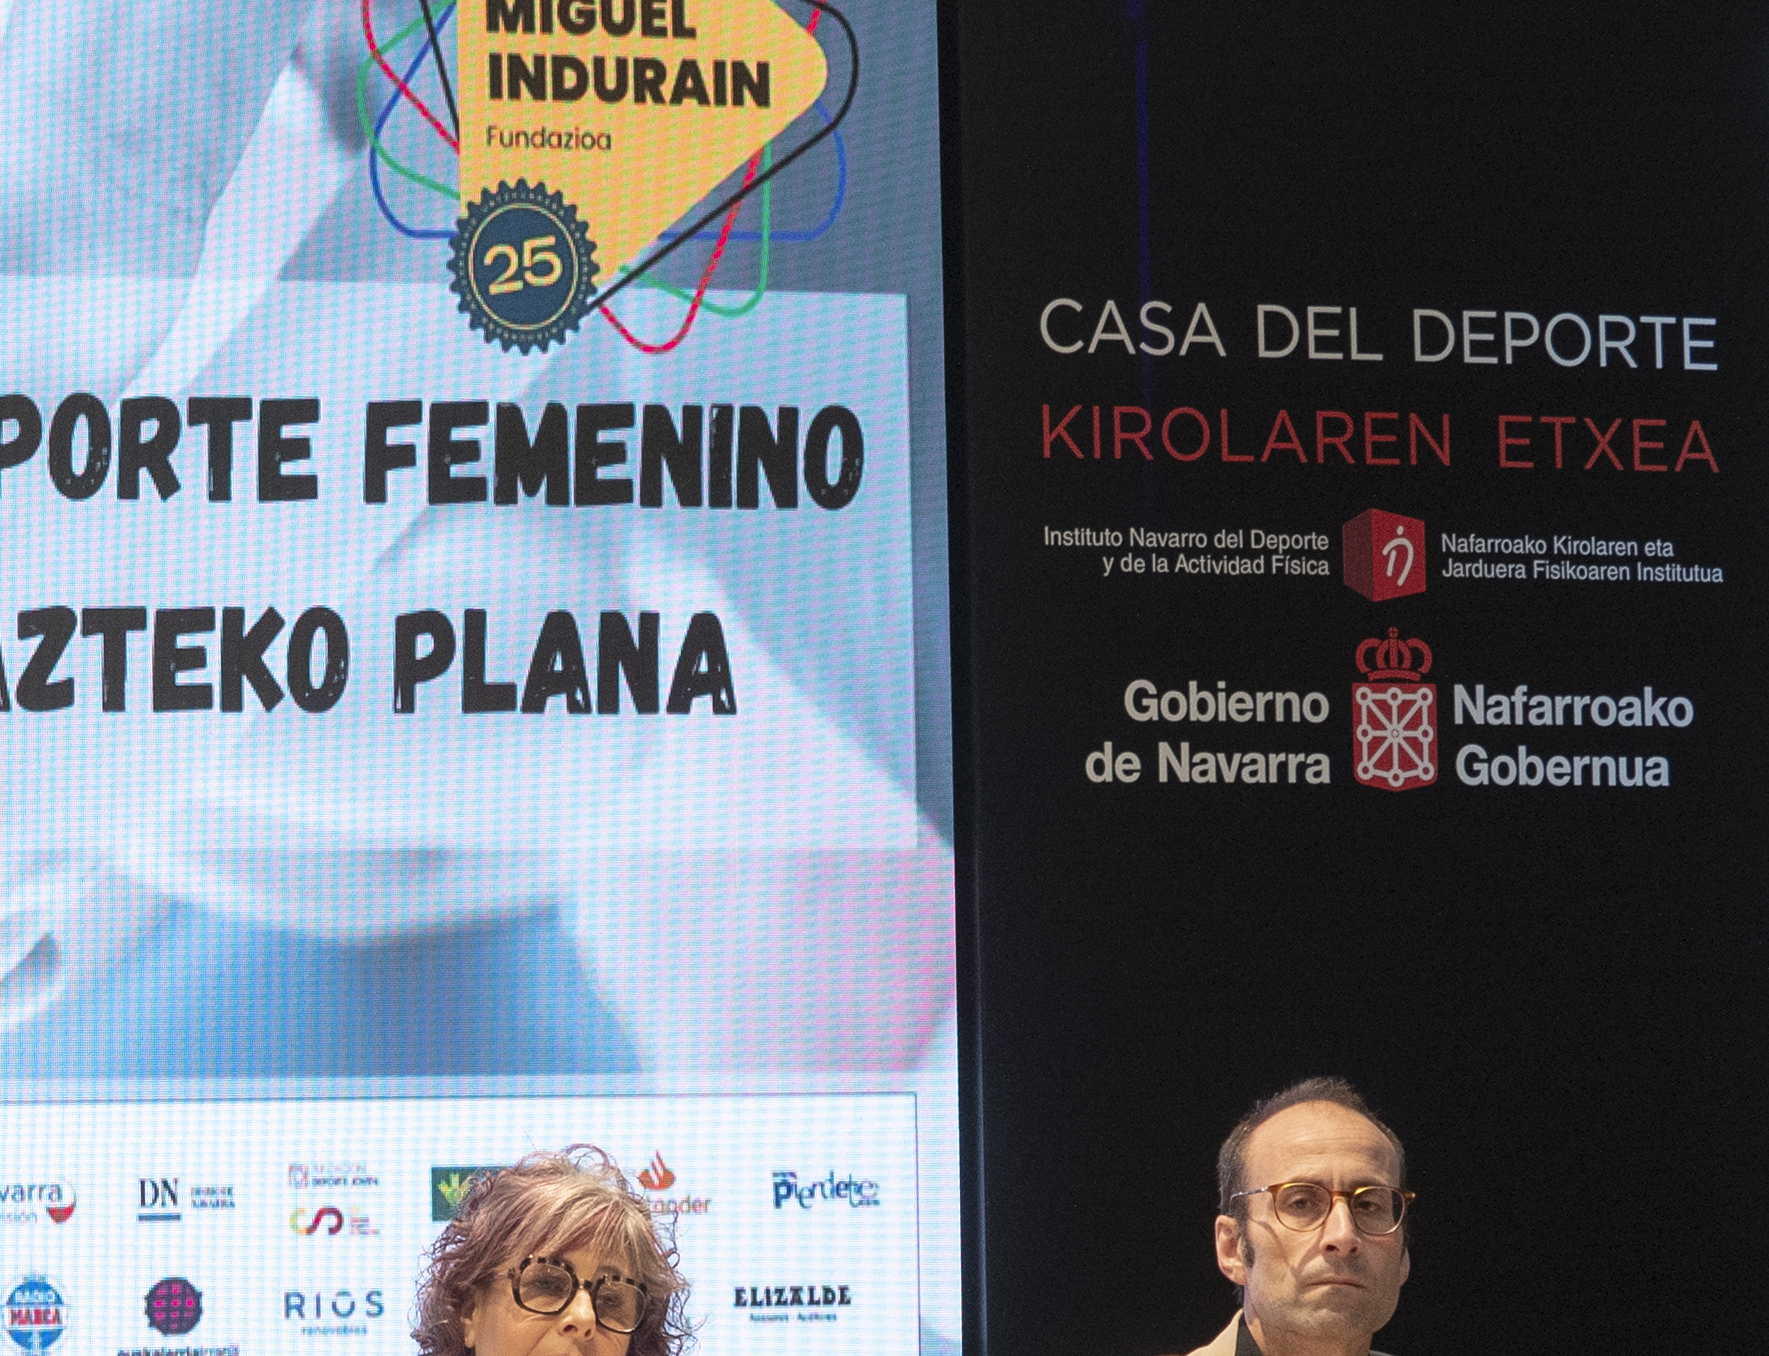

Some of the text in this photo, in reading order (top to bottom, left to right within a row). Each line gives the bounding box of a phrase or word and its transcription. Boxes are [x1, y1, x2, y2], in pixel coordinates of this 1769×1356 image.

[485, 0, 697, 39] MIGUEL
[487, 52, 771, 109] INDURAIN
[486, 126, 612, 151] Fundazioa
[483, 235, 564, 296] 25
[1039, 297, 1719, 371] CASA DEL DEPORTE
[363, 398, 866, 511] FEMENINO
[1041, 404, 1720, 474] KIROLAREN ETXEA
[1043, 526, 1330, 554] Instituto Navarro del Deporte
[1441, 533, 1675, 557] Nafarroako Kirolaren eta
[1102, 553, 1330, 577] y de la Actividad Física
[1441, 558, 1725, 584] Jarduera Fisikoaren Institutua
[392, 607, 738, 715] PLANA
[1123, 678, 1330, 724] Gobierno
[1453, 683, 1695, 729] Nafarroako
[1084, 741, 1331, 785] de Navarra
[1455, 743, 1671, 788] Gobernua
[138, 1177, 179, 1208] DN
[734, 1285, 852, 1308] ELIZALDE
